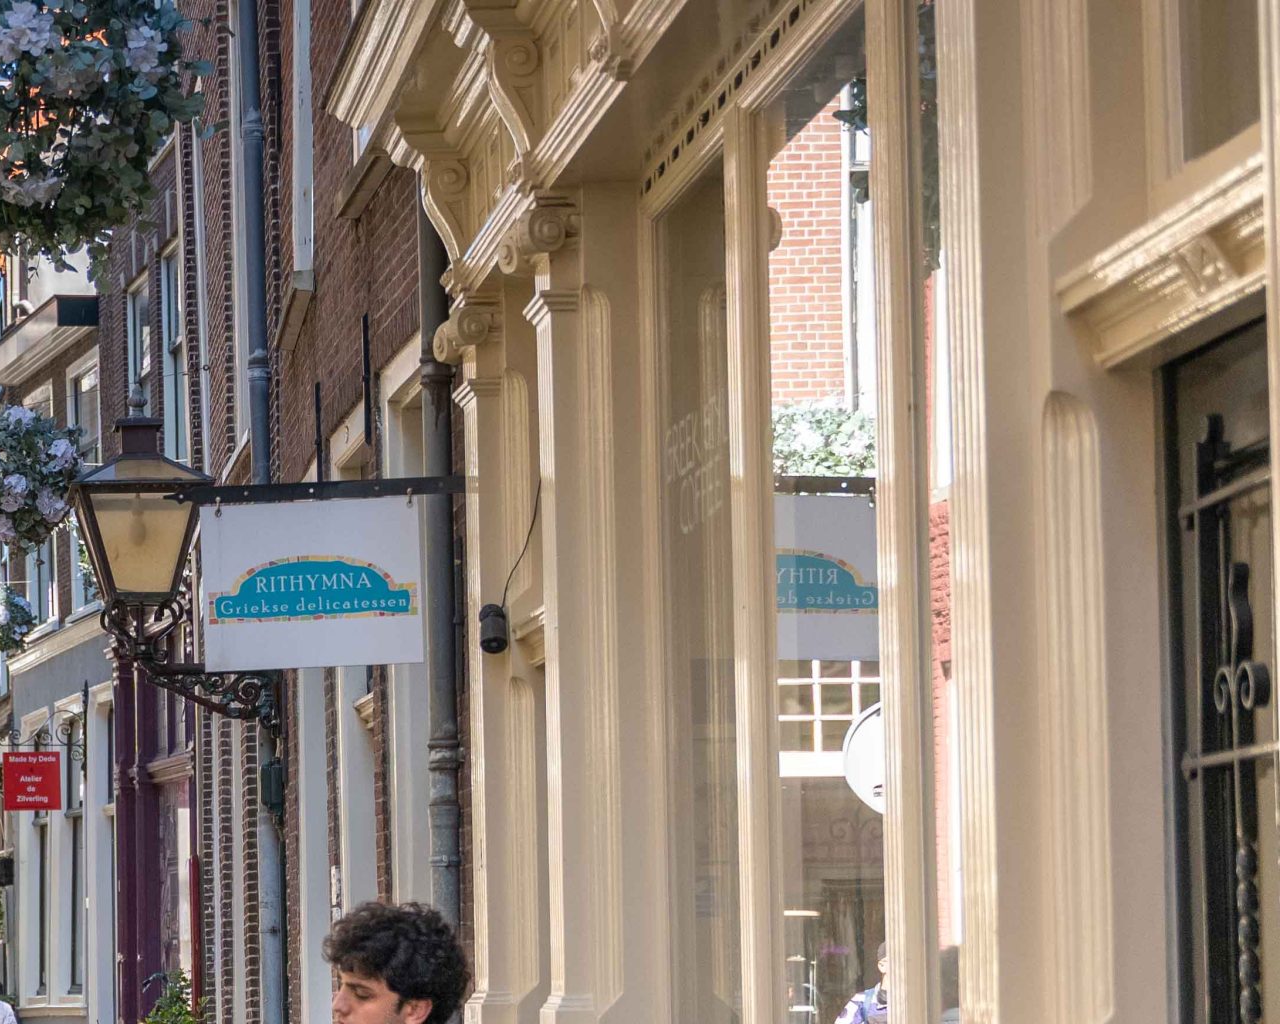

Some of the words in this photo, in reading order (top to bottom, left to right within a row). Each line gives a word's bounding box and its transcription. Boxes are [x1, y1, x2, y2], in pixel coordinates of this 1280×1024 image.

[255, 572, 372, 594] RITHYMNA
[220, 598, 289, 615] Griekse
[296, 596, 407, 612] delicatessen
[8, 755, 27, 763] Made
[28, 755, 38, 764] by
[19, 775, 43, 783] Atelier
[16, 794, 49, 804] Zilverling
